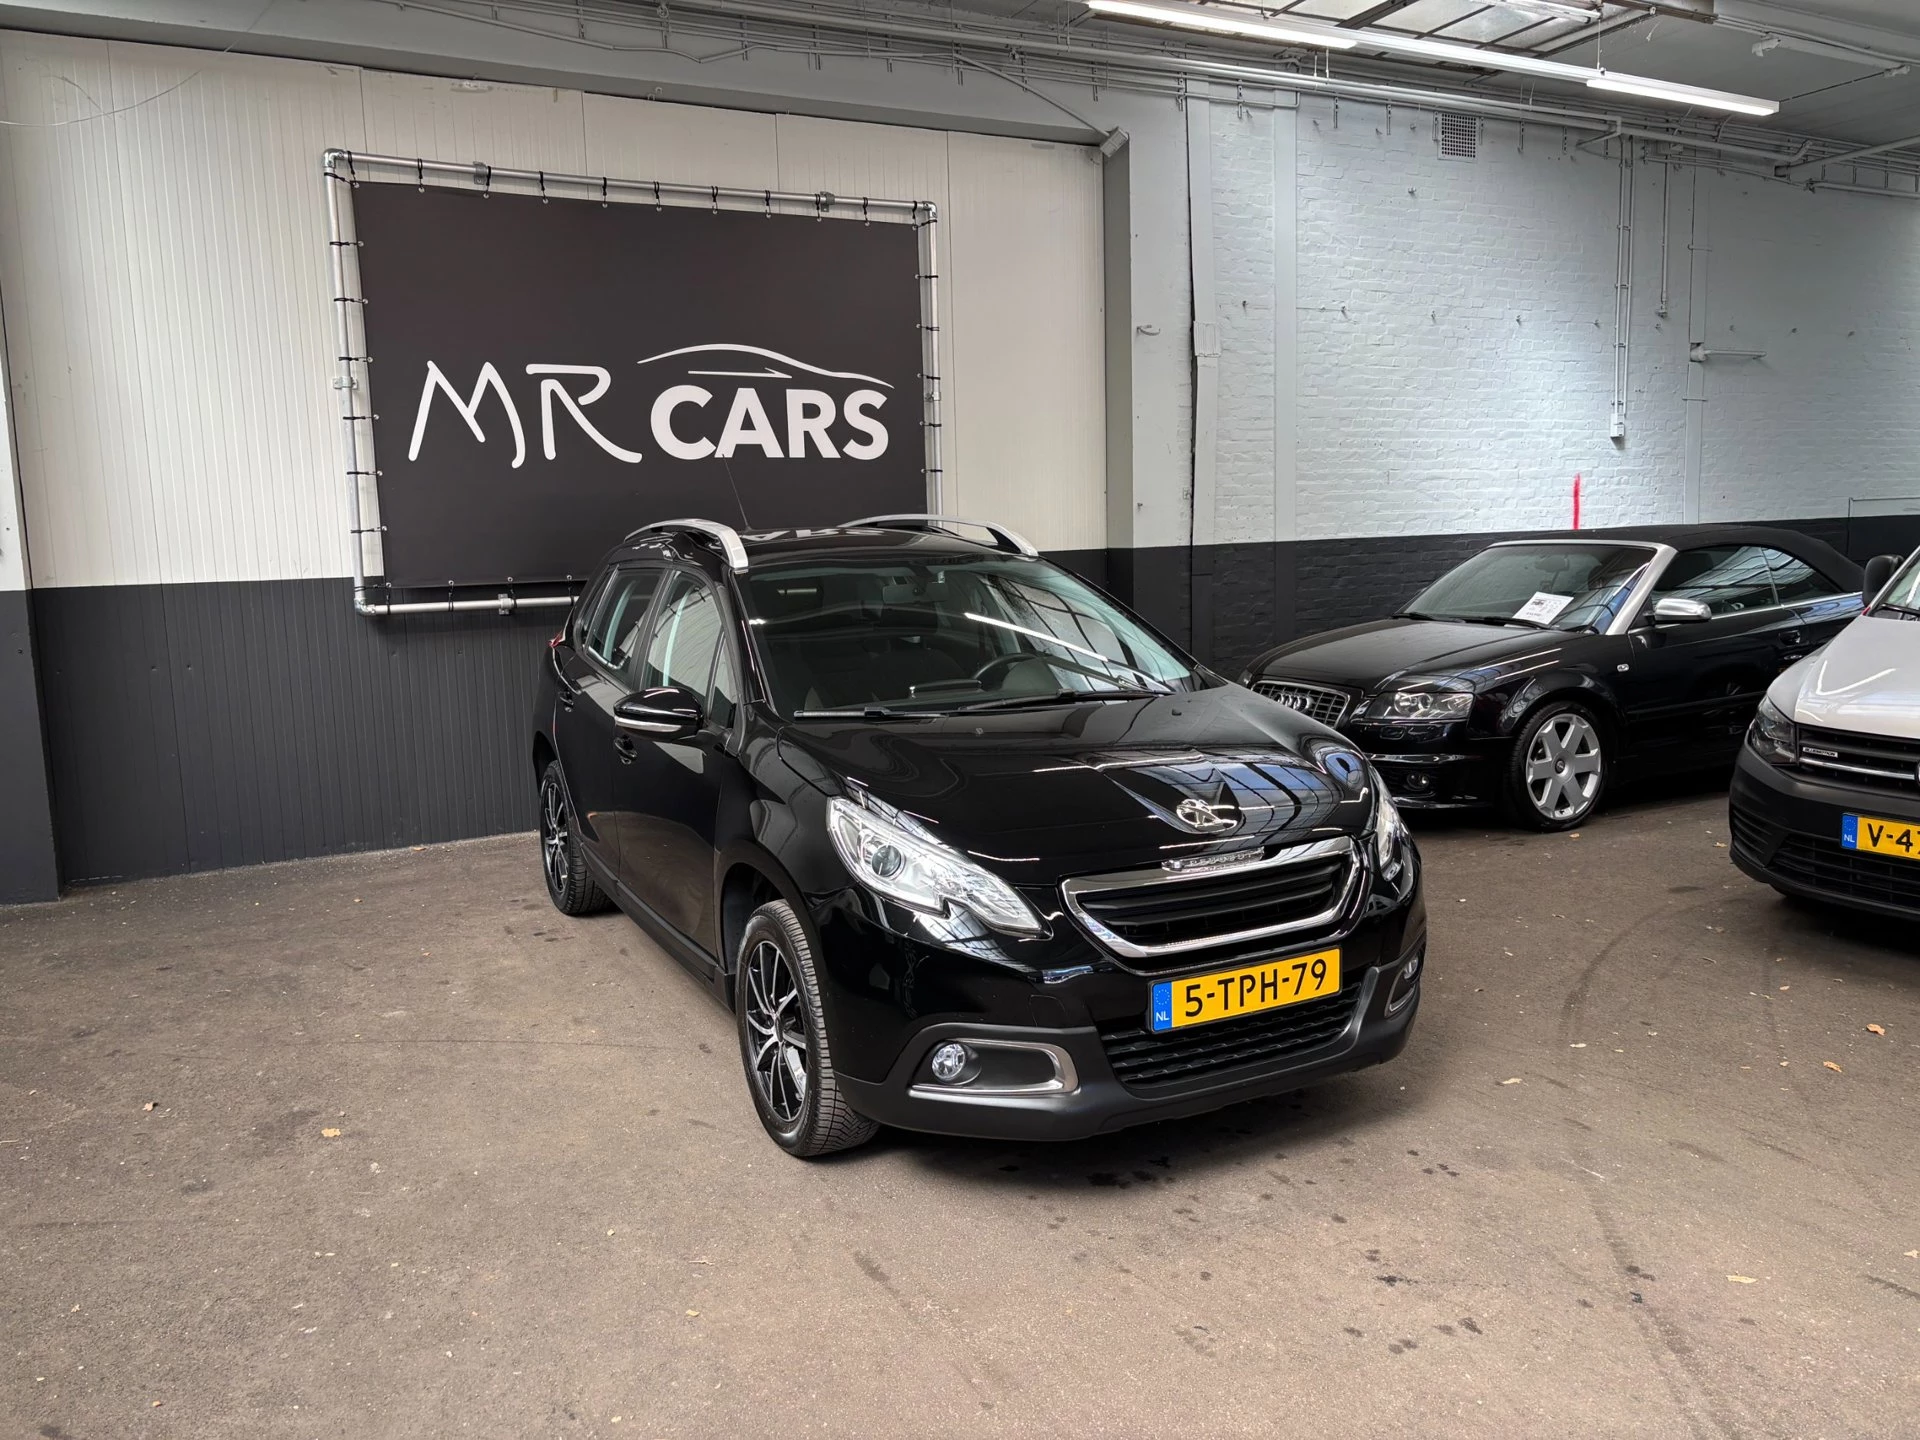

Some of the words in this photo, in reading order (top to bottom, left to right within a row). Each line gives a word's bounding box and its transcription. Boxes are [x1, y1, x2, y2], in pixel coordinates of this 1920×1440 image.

[407, 360, 643, 469] MR
[649, 383, 890, 461] CARS
[1843, 833, 1855, 843] NL
[1867, 823, 1920, 855] V-4
[1185, 958, 1327, 1017] 5-TPH-79
[1155, 1011, 1169, 1022] NL
